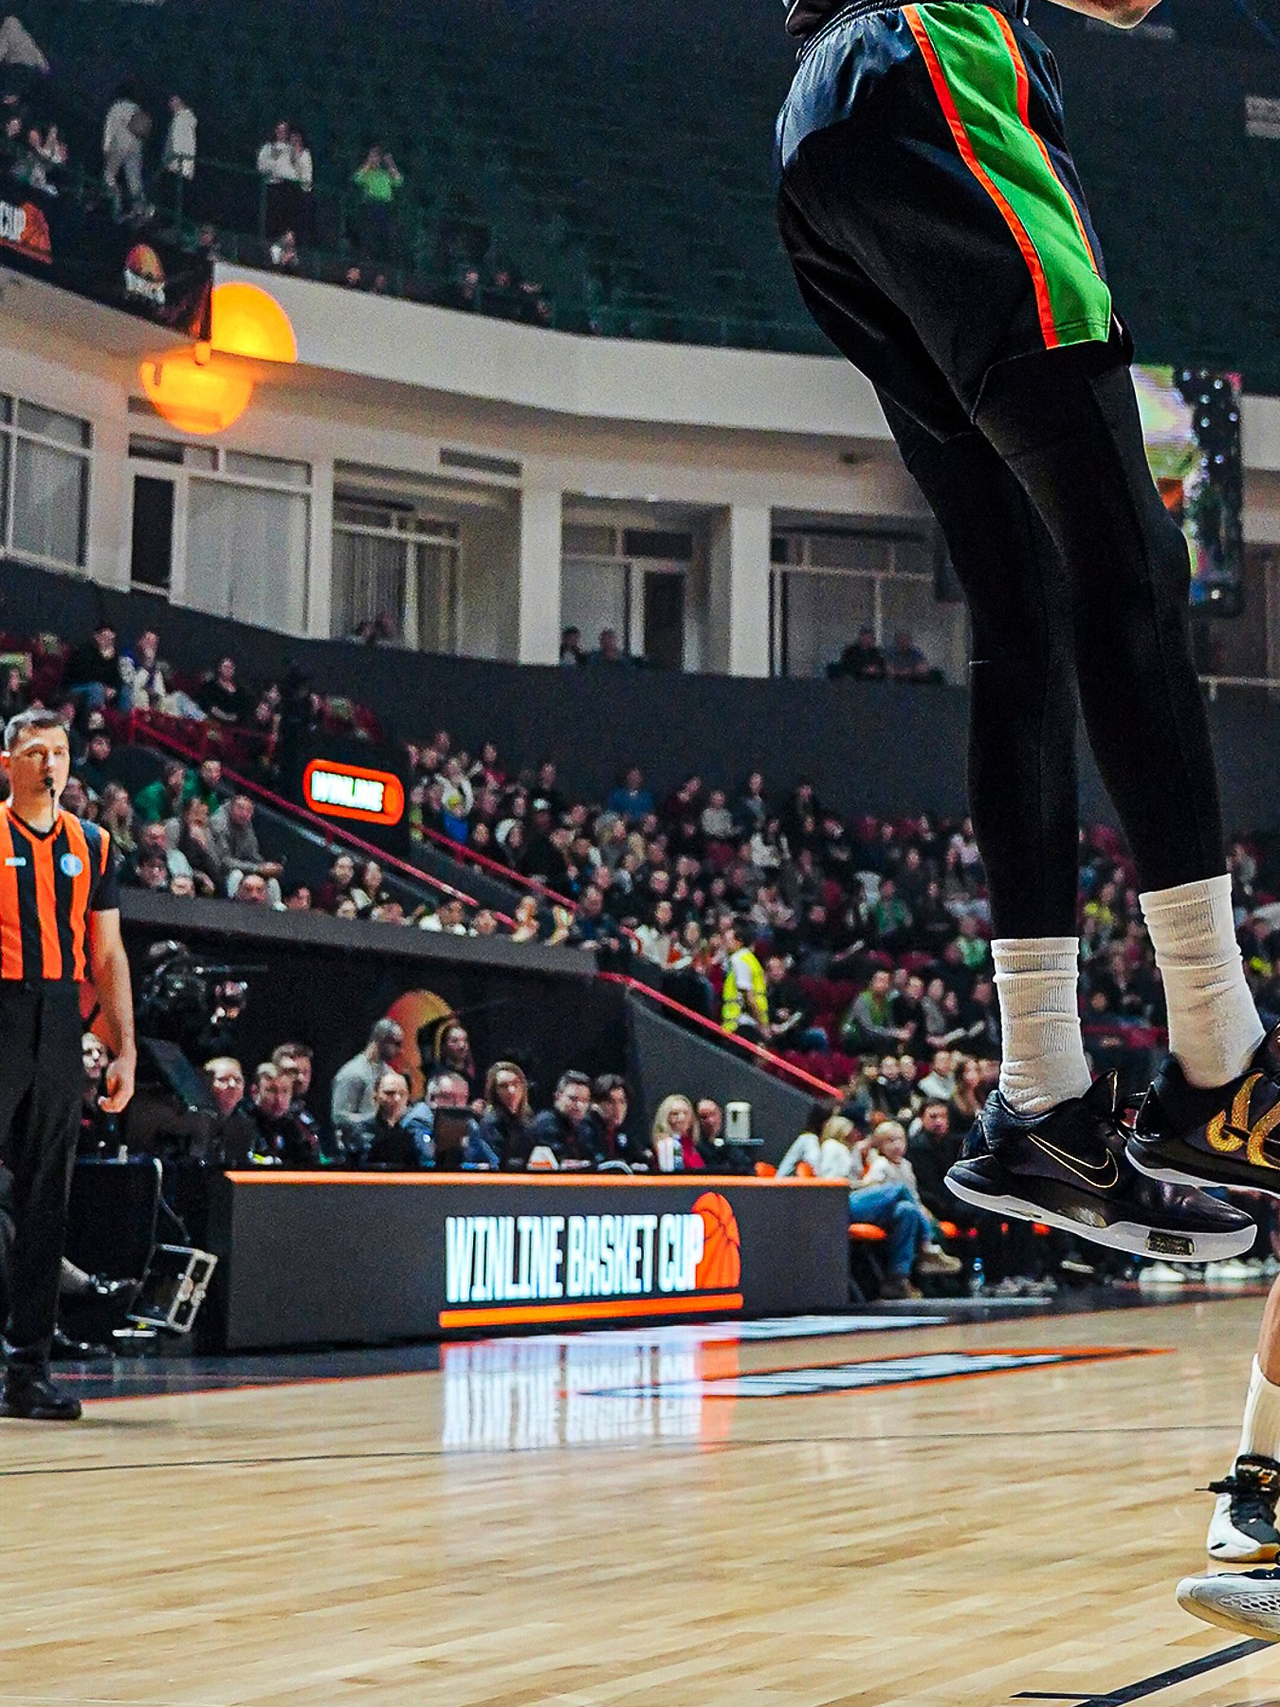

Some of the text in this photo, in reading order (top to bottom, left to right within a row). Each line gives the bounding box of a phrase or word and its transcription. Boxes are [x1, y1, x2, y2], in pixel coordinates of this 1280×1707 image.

[446, 1213, 704, 1302] WINLINE BASKET CUP
